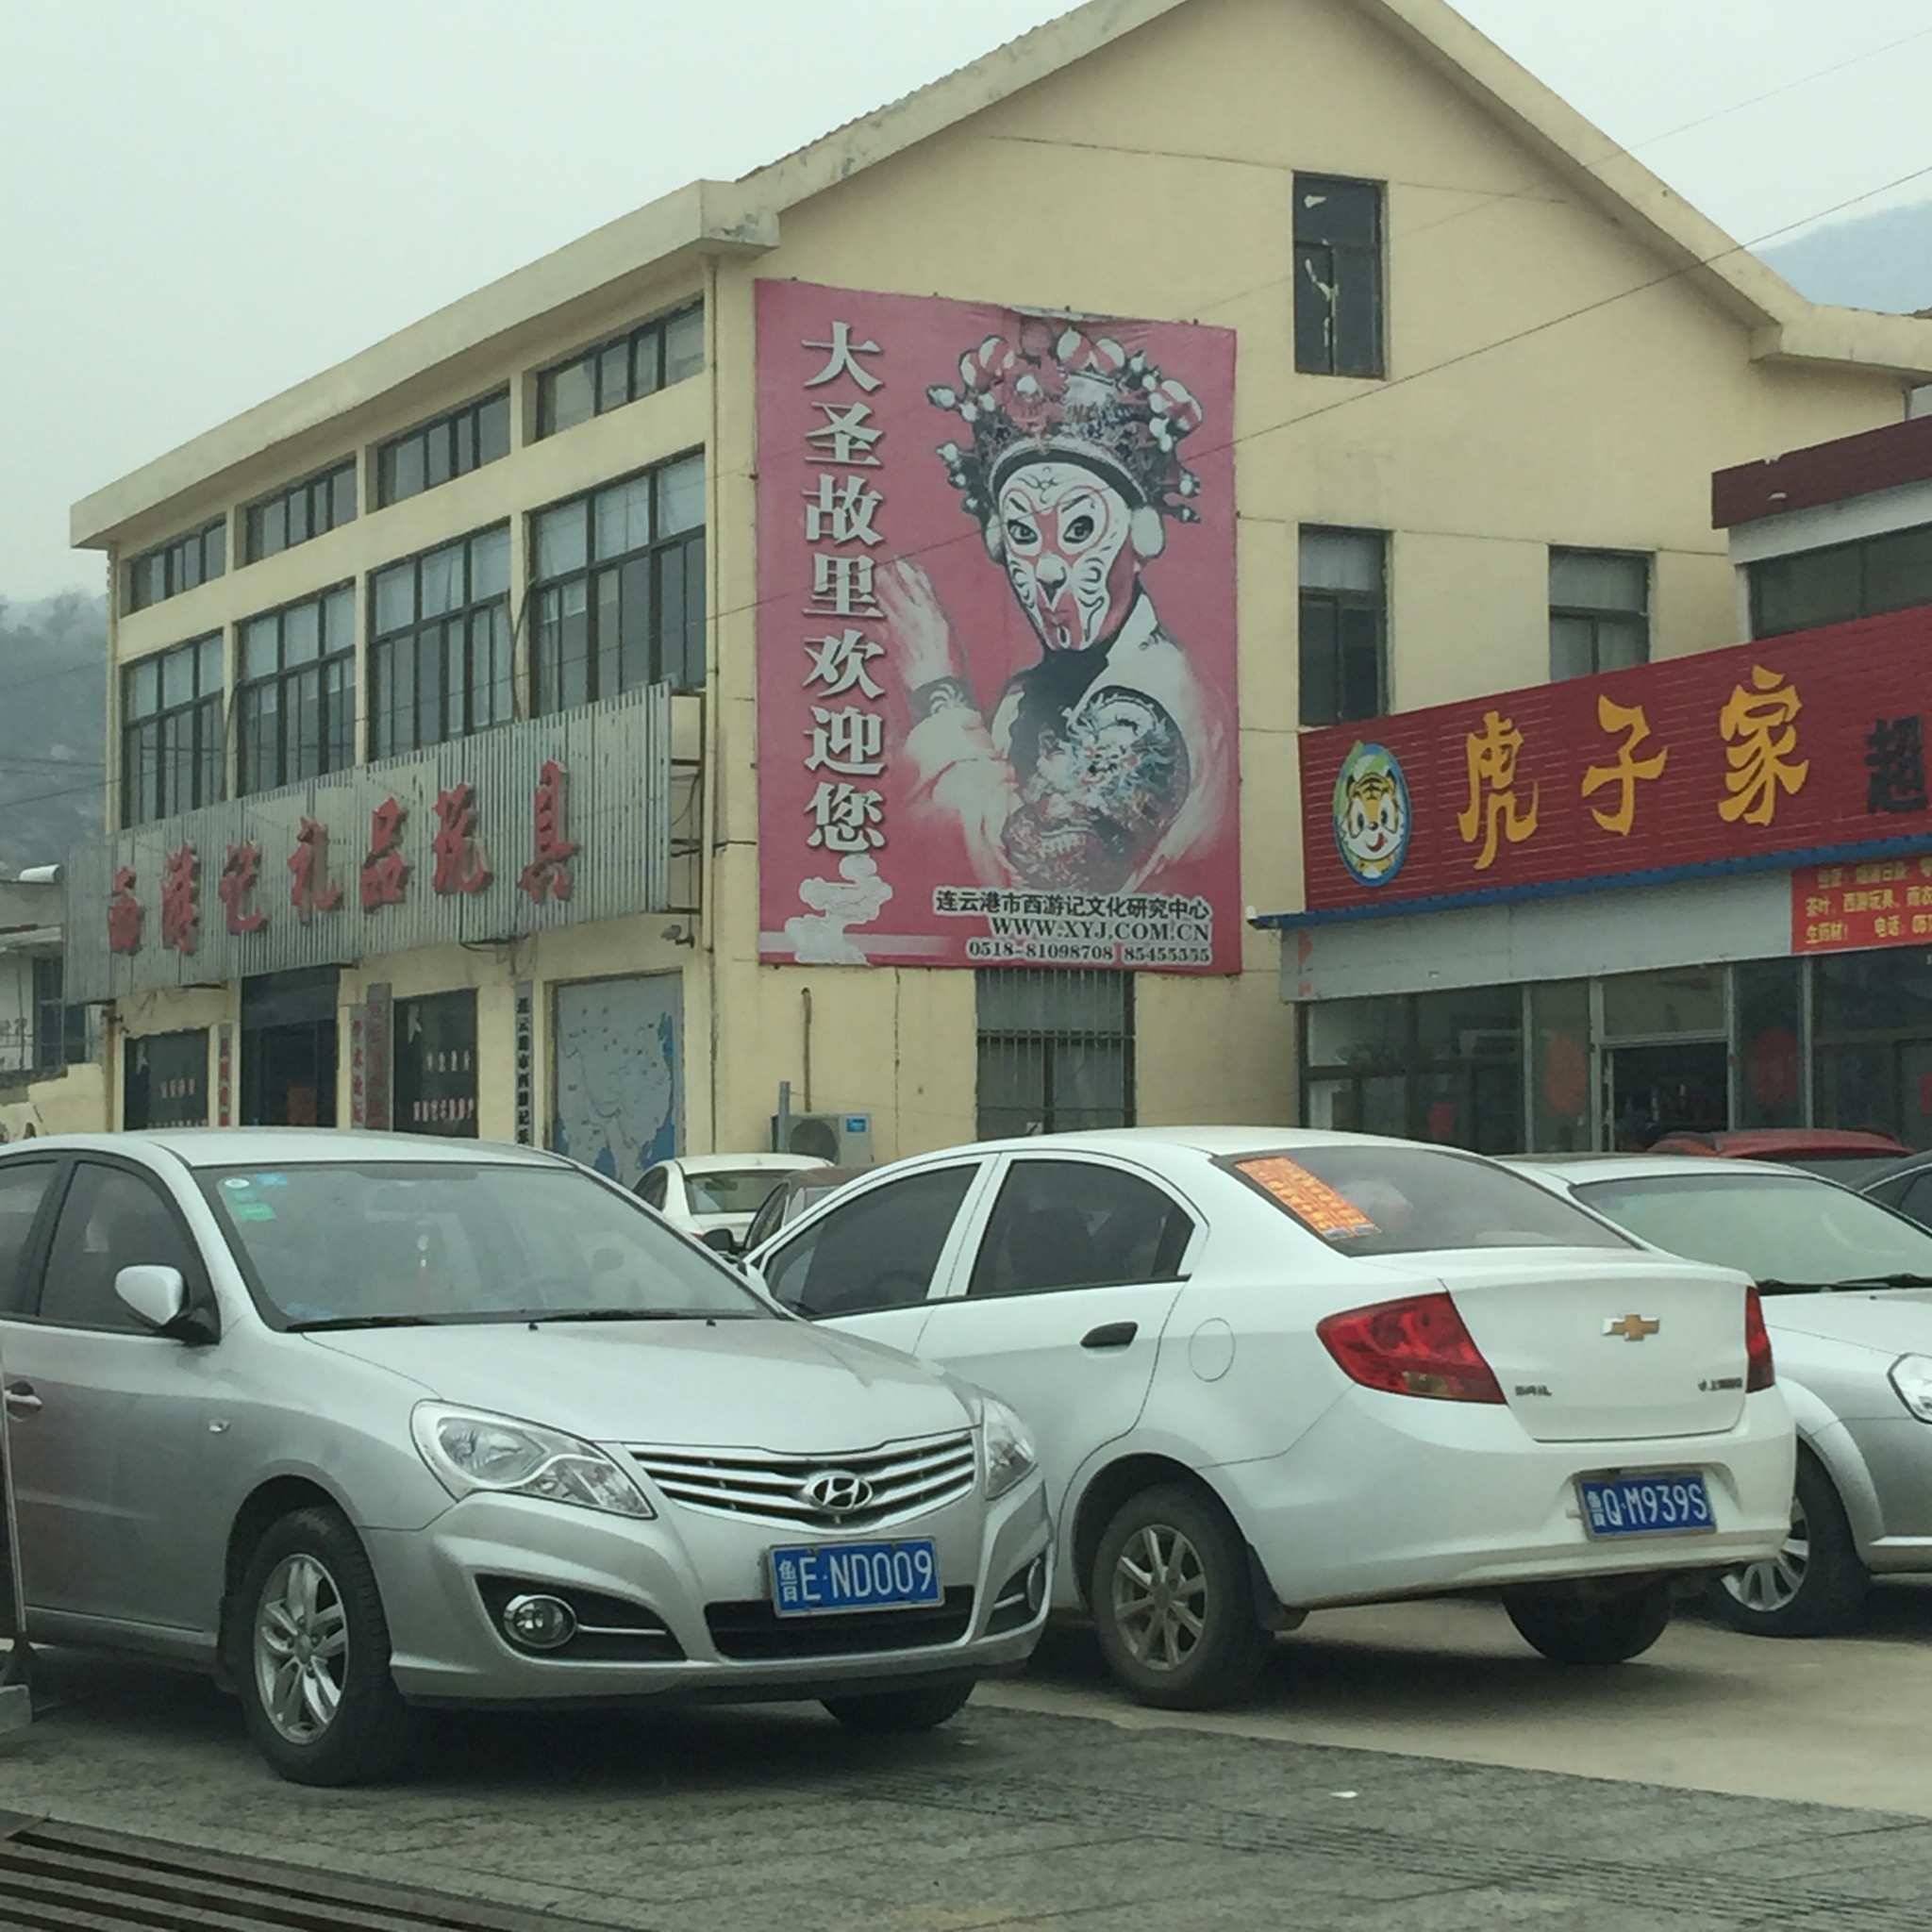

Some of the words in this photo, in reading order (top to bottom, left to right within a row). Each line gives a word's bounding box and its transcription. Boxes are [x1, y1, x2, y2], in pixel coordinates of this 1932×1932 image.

[802, 321, 886, 852] 大圣故里欢迎您
[1457, 664, 1809, 871] 虎子家
[936, 890, 1210, 921] 连云港市西游记文化研究中心
[991, 917, 1210, 941] WWW.XYJ.COM.CN
[969, 941, 1114, 960] 0518-81098708
